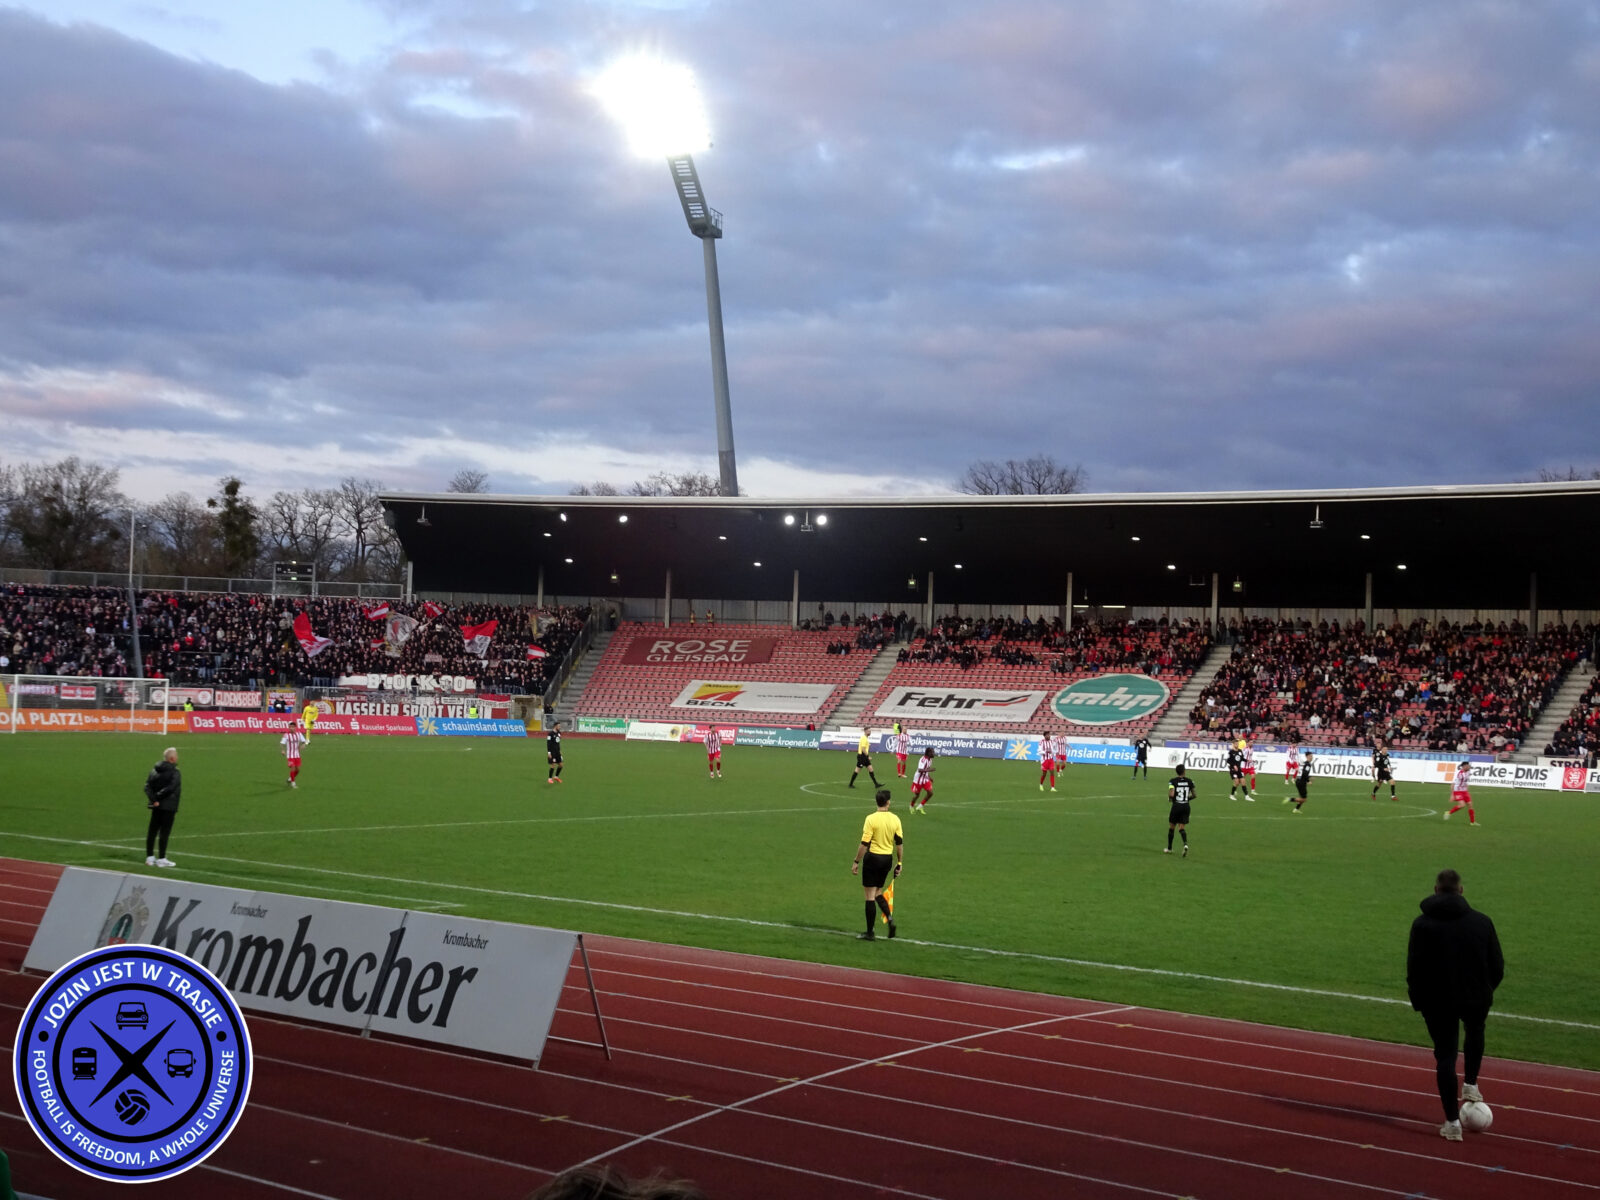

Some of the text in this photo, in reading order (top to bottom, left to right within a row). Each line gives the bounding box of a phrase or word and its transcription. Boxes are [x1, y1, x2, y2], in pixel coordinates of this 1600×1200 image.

[650, 640, 751, 653] ROSE
[647, 653, 746, 662] GLEISBAU
[686, 700, 737, 708] BECK
[897, 692, 983, 709] Fehr
[336, 702, 493, 719] KASSELER SPORT VEIN
[29, 712, 84, 726] PLATZ!
[84, 715, 99, 723] Die
[193, 717, 344, 730] Das Team für dein Fianzen.
[387, 724, 414, 732] Sparkasse
[442, 721, 525, 733] schauinsland reisen
[908, 737, 1003, 750] olkswagen Werk Kassel
[1109, 749, 1137, 760] reise
[1183, 751, 1266, 771] Kromber
[1303, 758, 1398, 777] Krombacr
[1550, 760, 1585, 769] STRÖ
[1176, 786, 1190, 801] 31
[443, 929, 489, 949] Krombacher
[152, 896, 479, 1029] Krombacher
